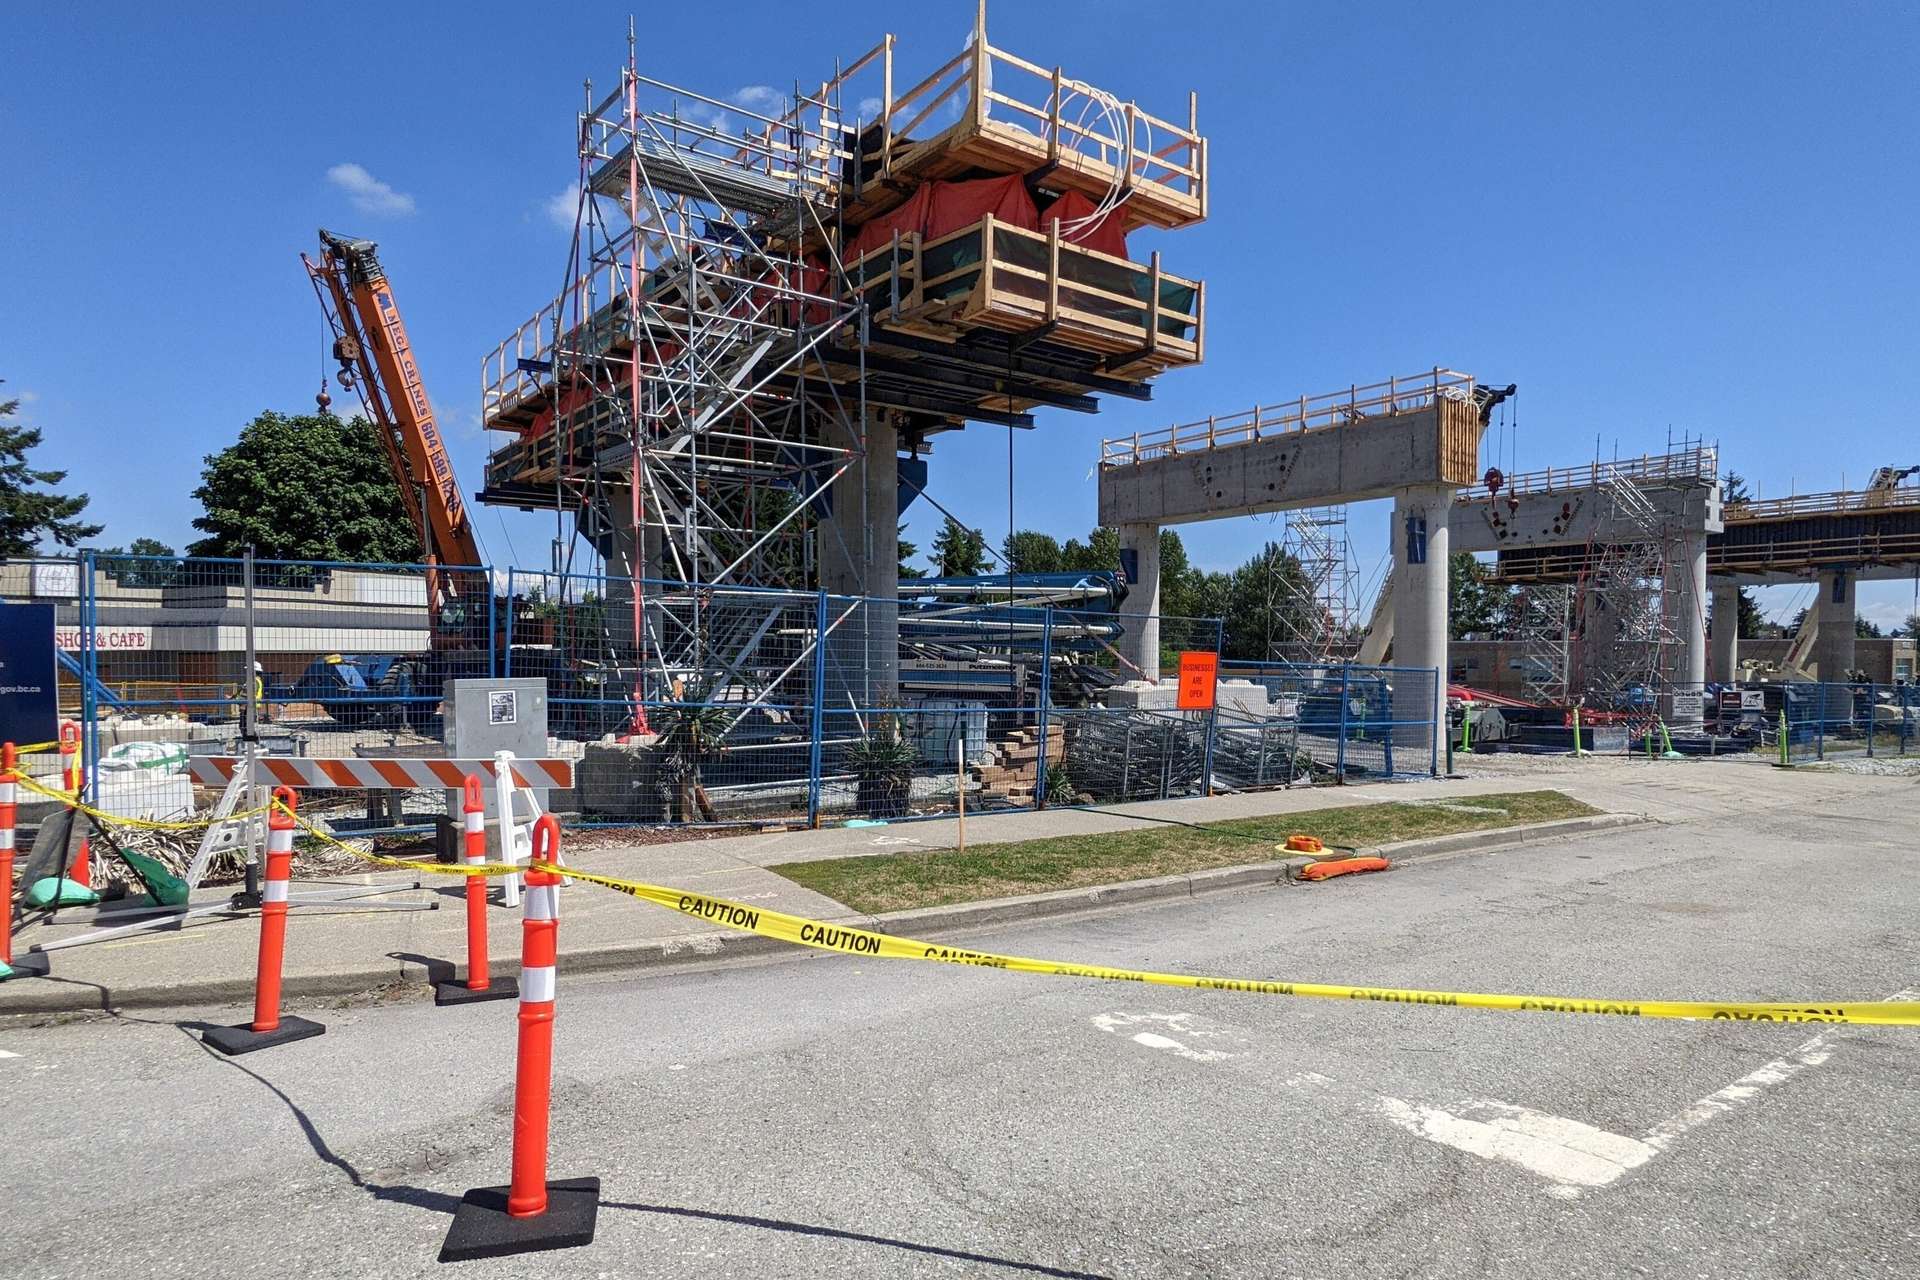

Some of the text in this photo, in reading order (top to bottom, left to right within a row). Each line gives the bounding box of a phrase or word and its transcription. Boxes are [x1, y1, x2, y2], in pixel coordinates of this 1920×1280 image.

[97, 632, 107, 648] &
[110, 632, 146, 648] CAFE
[1192, 676, 1204, 685] ARE
[678, 895, 760, 930] CAUTION
[799, 923, 882, 954] CAUTION
